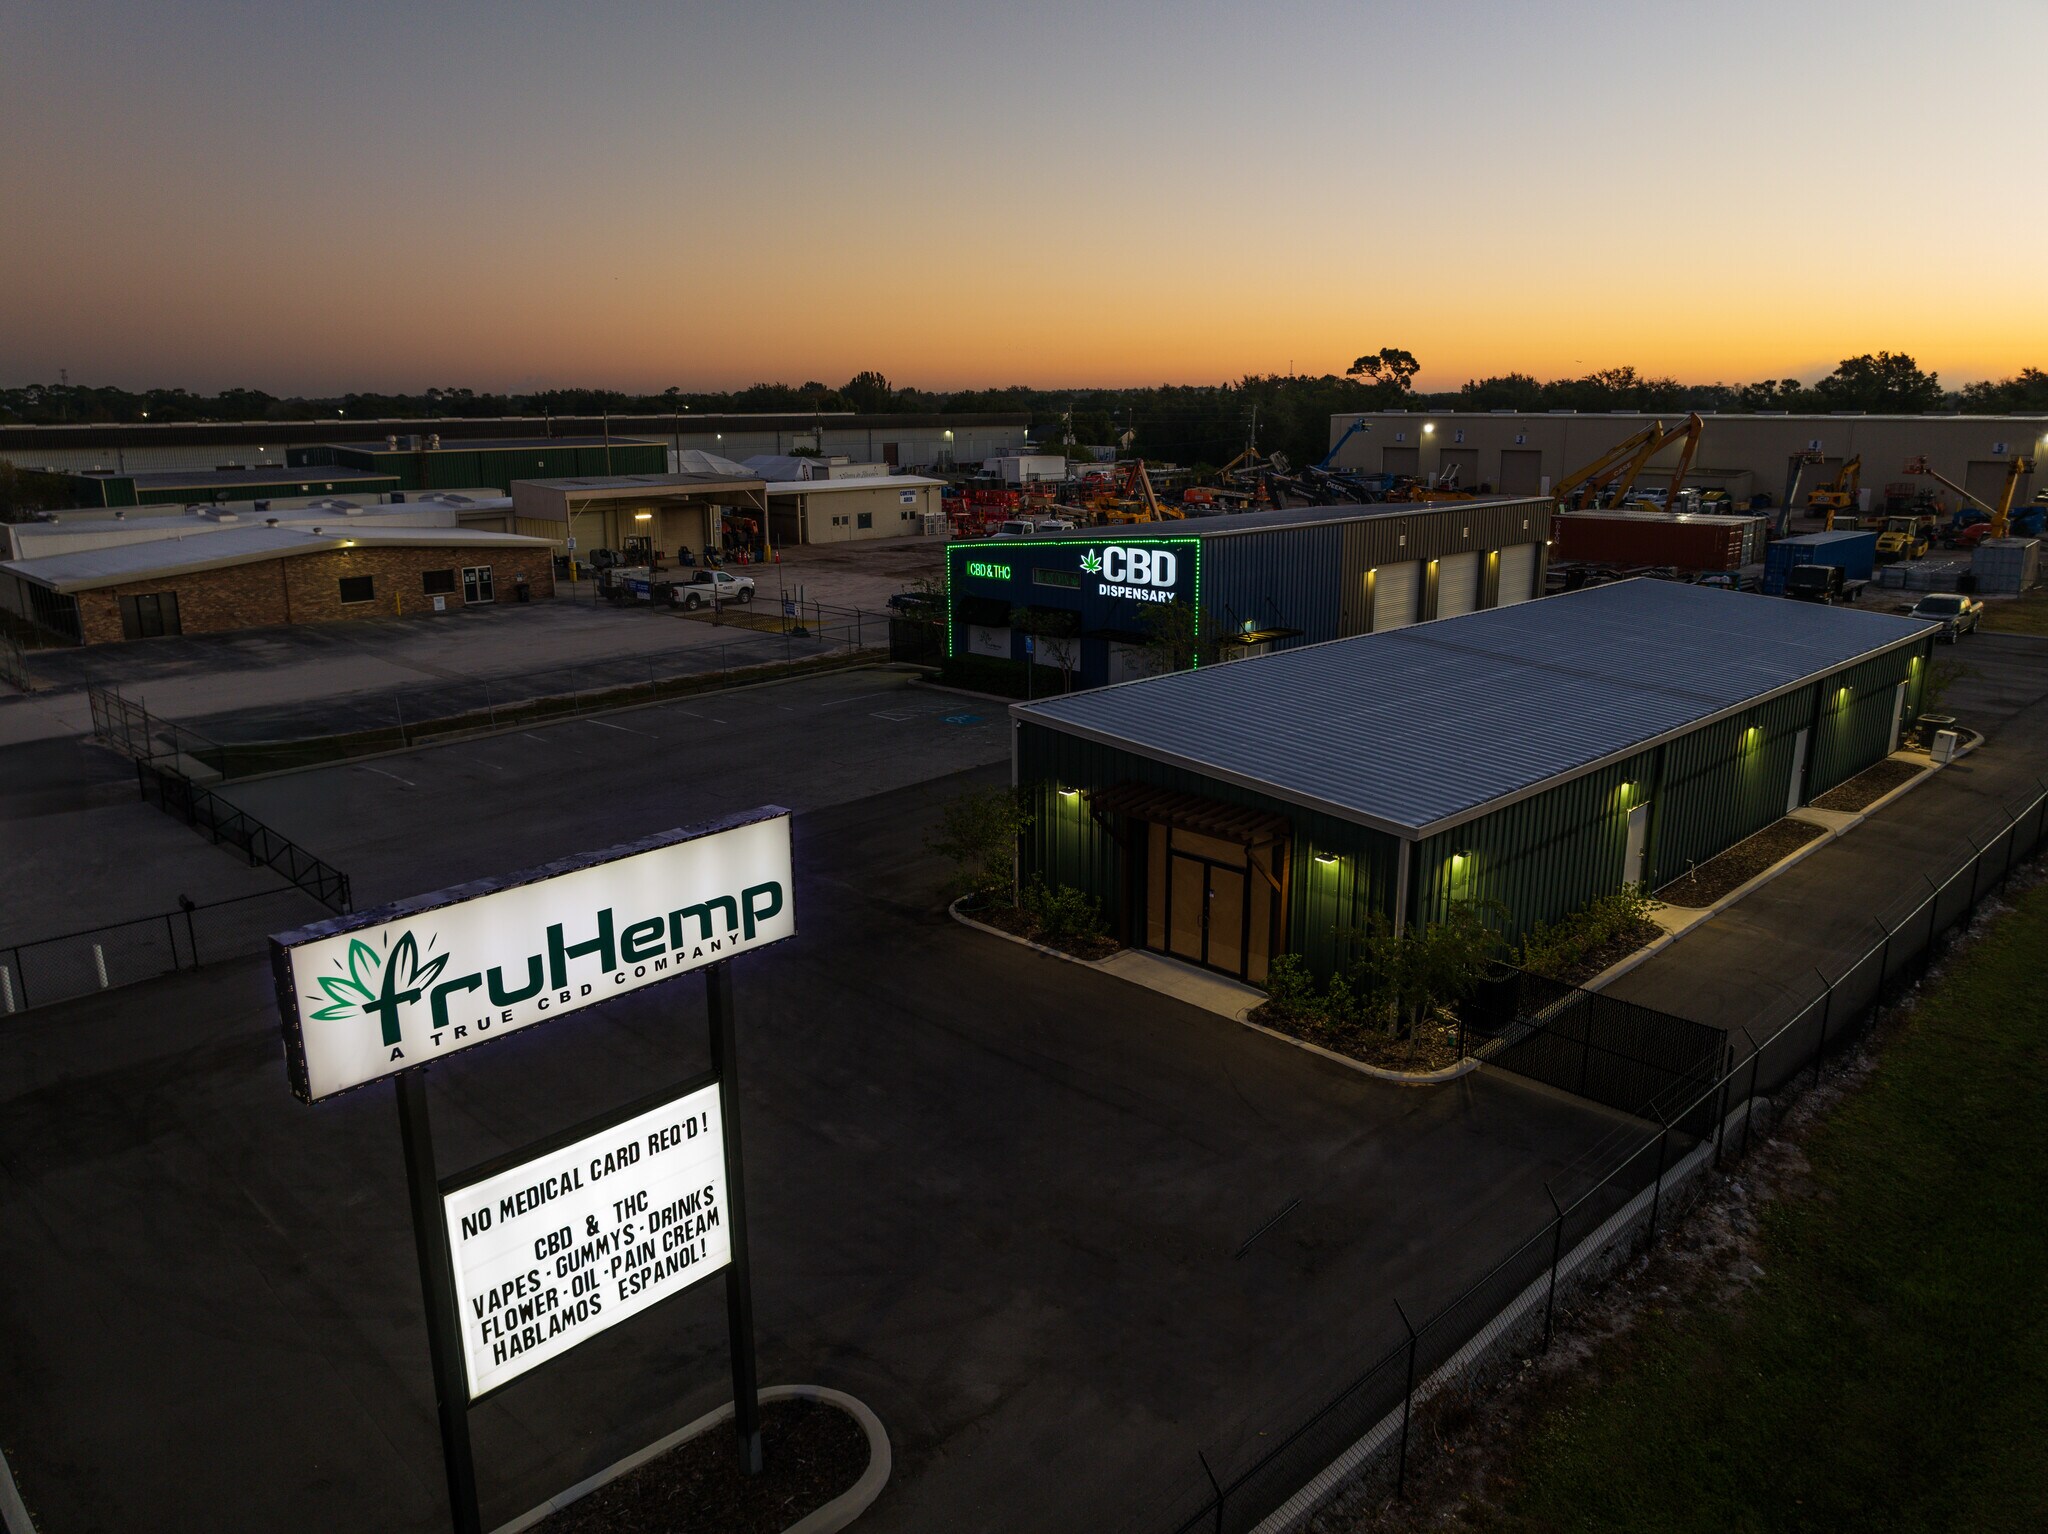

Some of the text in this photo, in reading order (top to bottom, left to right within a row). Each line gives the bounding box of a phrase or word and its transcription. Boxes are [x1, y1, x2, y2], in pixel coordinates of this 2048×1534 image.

[1326, 481, 1347, 494] DEERE
[970, 562, 1011, 580] CBD & THC
[1098, 583, 1175, 604] DISPENSARY
[1102, 546, 1177, 588] CBD
[390, 932, 740, 1062] A TRUE CBD COMPANY
[461, 1207, 493, 1240] NO
[500, 1167, 584, 1224] MEDICAL
[590, 1141, 641, 1182] CARD
[534, 1189, 649, 1261] CBD & THC
[472, 1184, 715, 1320] VAPES GUMMYS DRINKS
[481, 1206, 720, 1345] FLOWER OIL PAIN CREAM
[492, 1238, 707, 1367] HABLAMOS ESPANOL!
